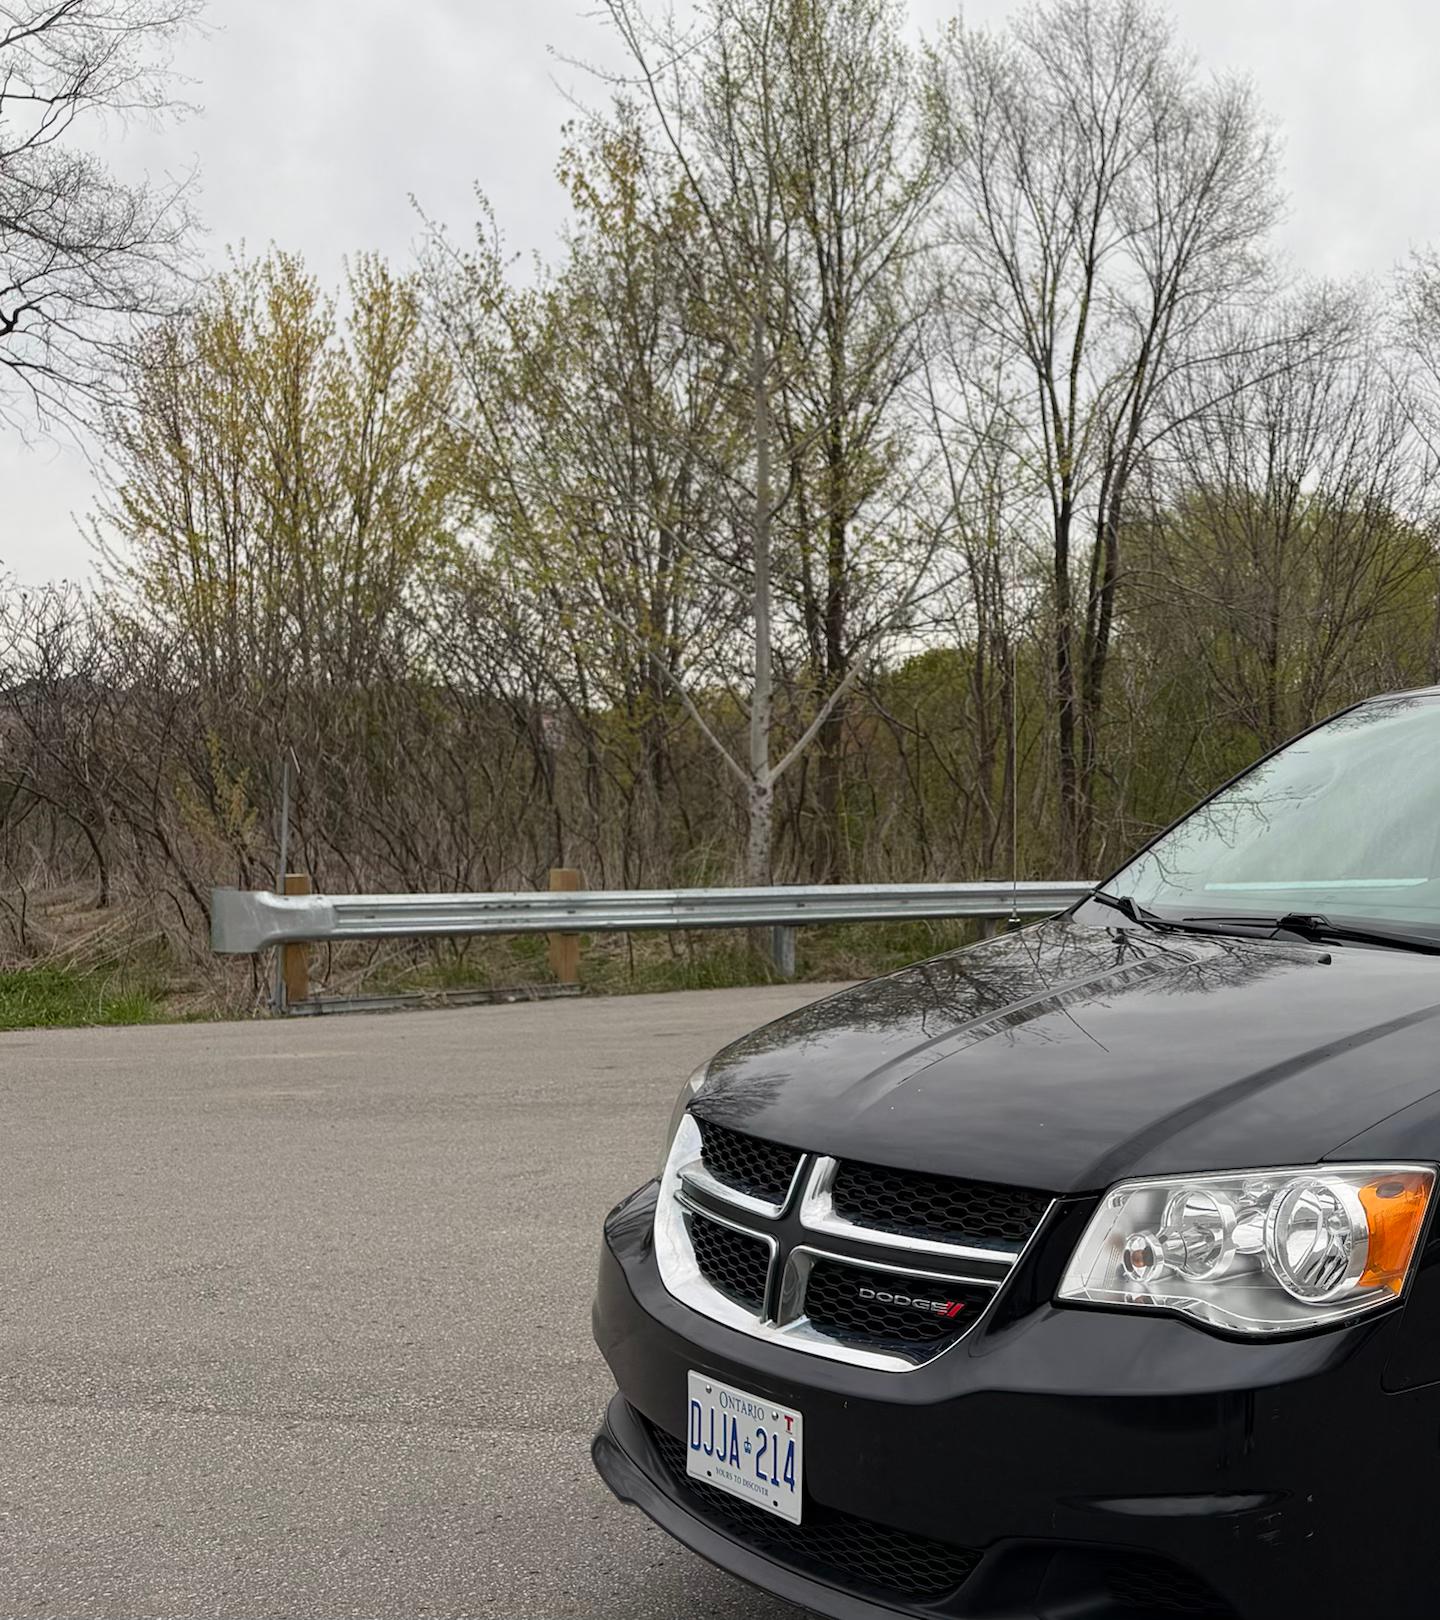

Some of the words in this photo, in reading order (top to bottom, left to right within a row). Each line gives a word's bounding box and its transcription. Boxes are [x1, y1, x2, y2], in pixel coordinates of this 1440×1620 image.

[859, 1288, 949, 1313] DODGE
[720, 1391, 764, 1421] ONTARIO
[690, 1400, 741, 1469] DJJA
[755, 1427, 796, 1492] 214
[734, 1474, 742, 1484] TO
